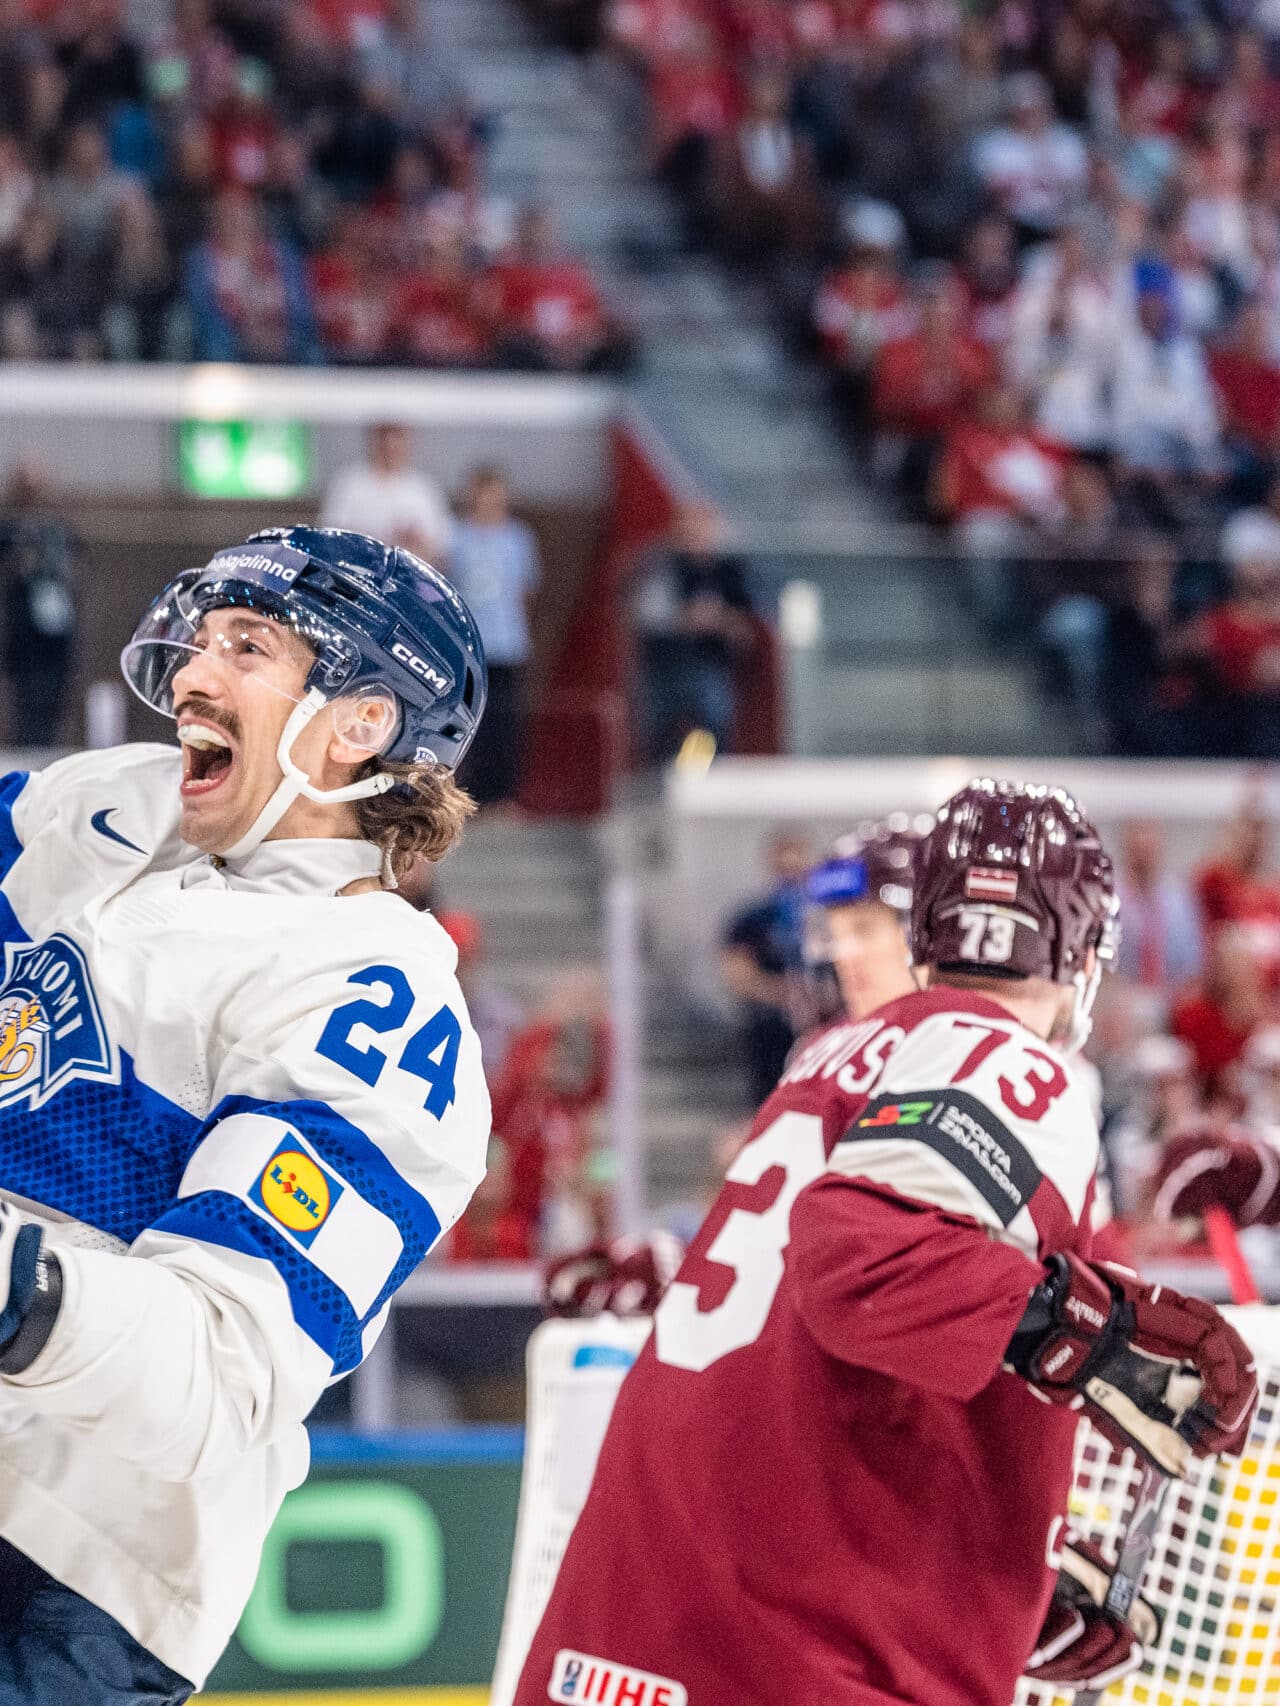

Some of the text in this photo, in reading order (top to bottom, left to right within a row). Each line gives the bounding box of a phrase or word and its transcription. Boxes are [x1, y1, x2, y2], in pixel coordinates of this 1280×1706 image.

[391, 642, 449, 690] CCM
[959, 910, 1015, 963] 73
[16, 950, 83, 1041] SUOMI
[314, 964, 462, 1122] 24
[950, 1020, 1068, 1122] 73
[583, 1666, 673, 1706] IIHF
